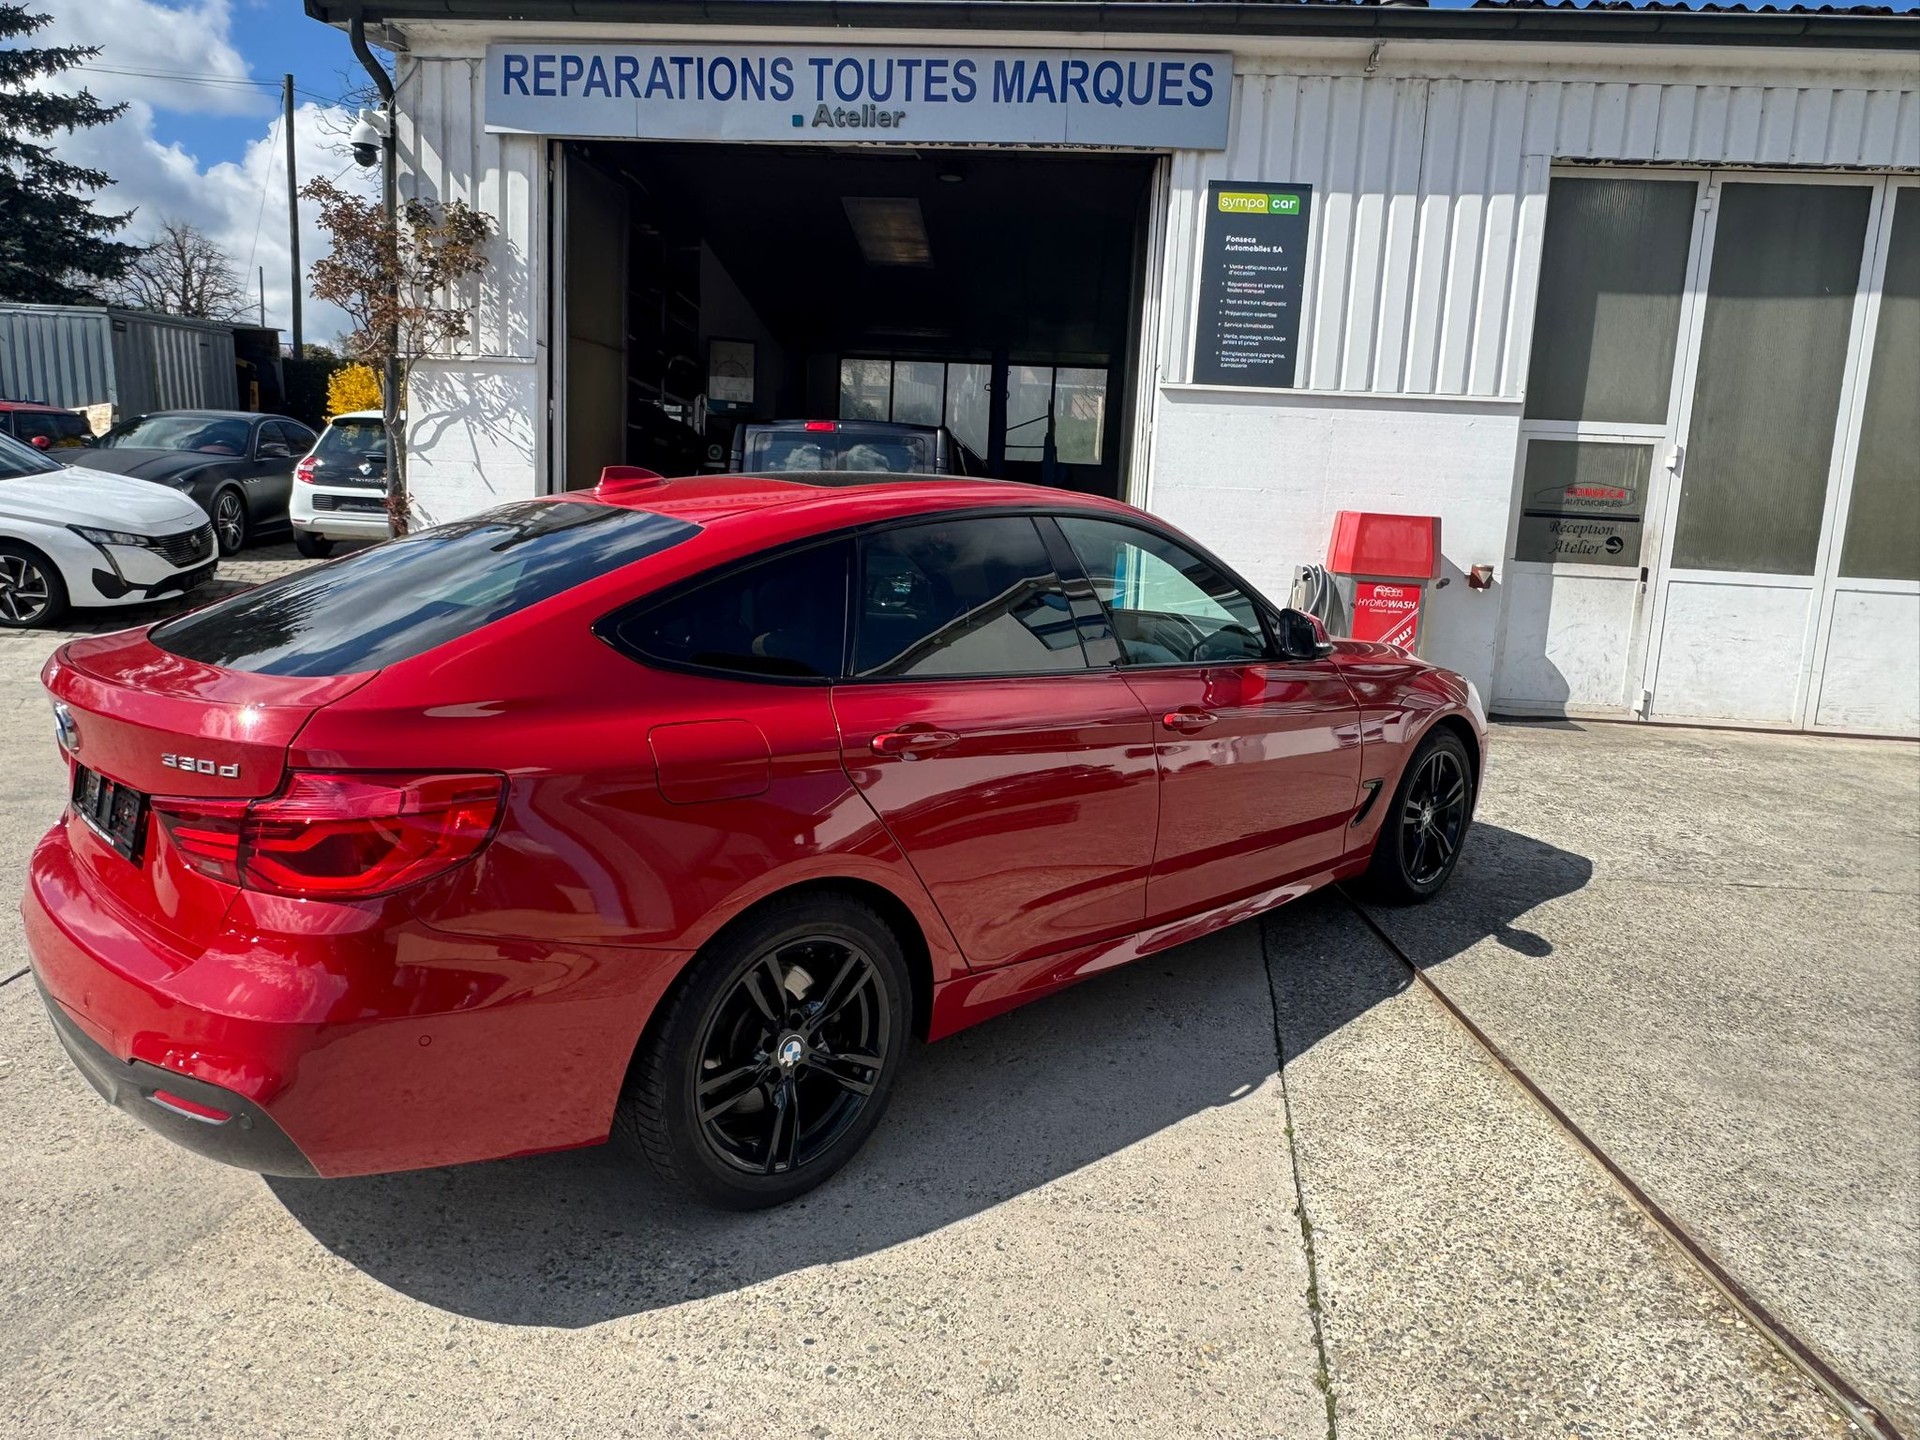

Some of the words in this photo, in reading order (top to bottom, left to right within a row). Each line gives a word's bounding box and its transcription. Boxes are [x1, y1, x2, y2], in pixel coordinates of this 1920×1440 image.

[503, 54, 795, 101] REPARATIONS
[808, 57, 977, 102] TOUTES
[993, 60, 1214, 108] MARQUES
[811, 103, 906, 128] Atelier
[1221, 197, 1265, 210] sympa
[1272, 199, 1297, 209] car
[1225, 235, 1257, 243] Fonseca
[1225, 244, 1271, 253] Automobiles
[1549, 520, 1615, 538] Réception
[1548, 539, 1605, 555] Atelier
[1357, 598, 1417, 609] HYDROWASH
[161, 752, 240, 779] 330d
